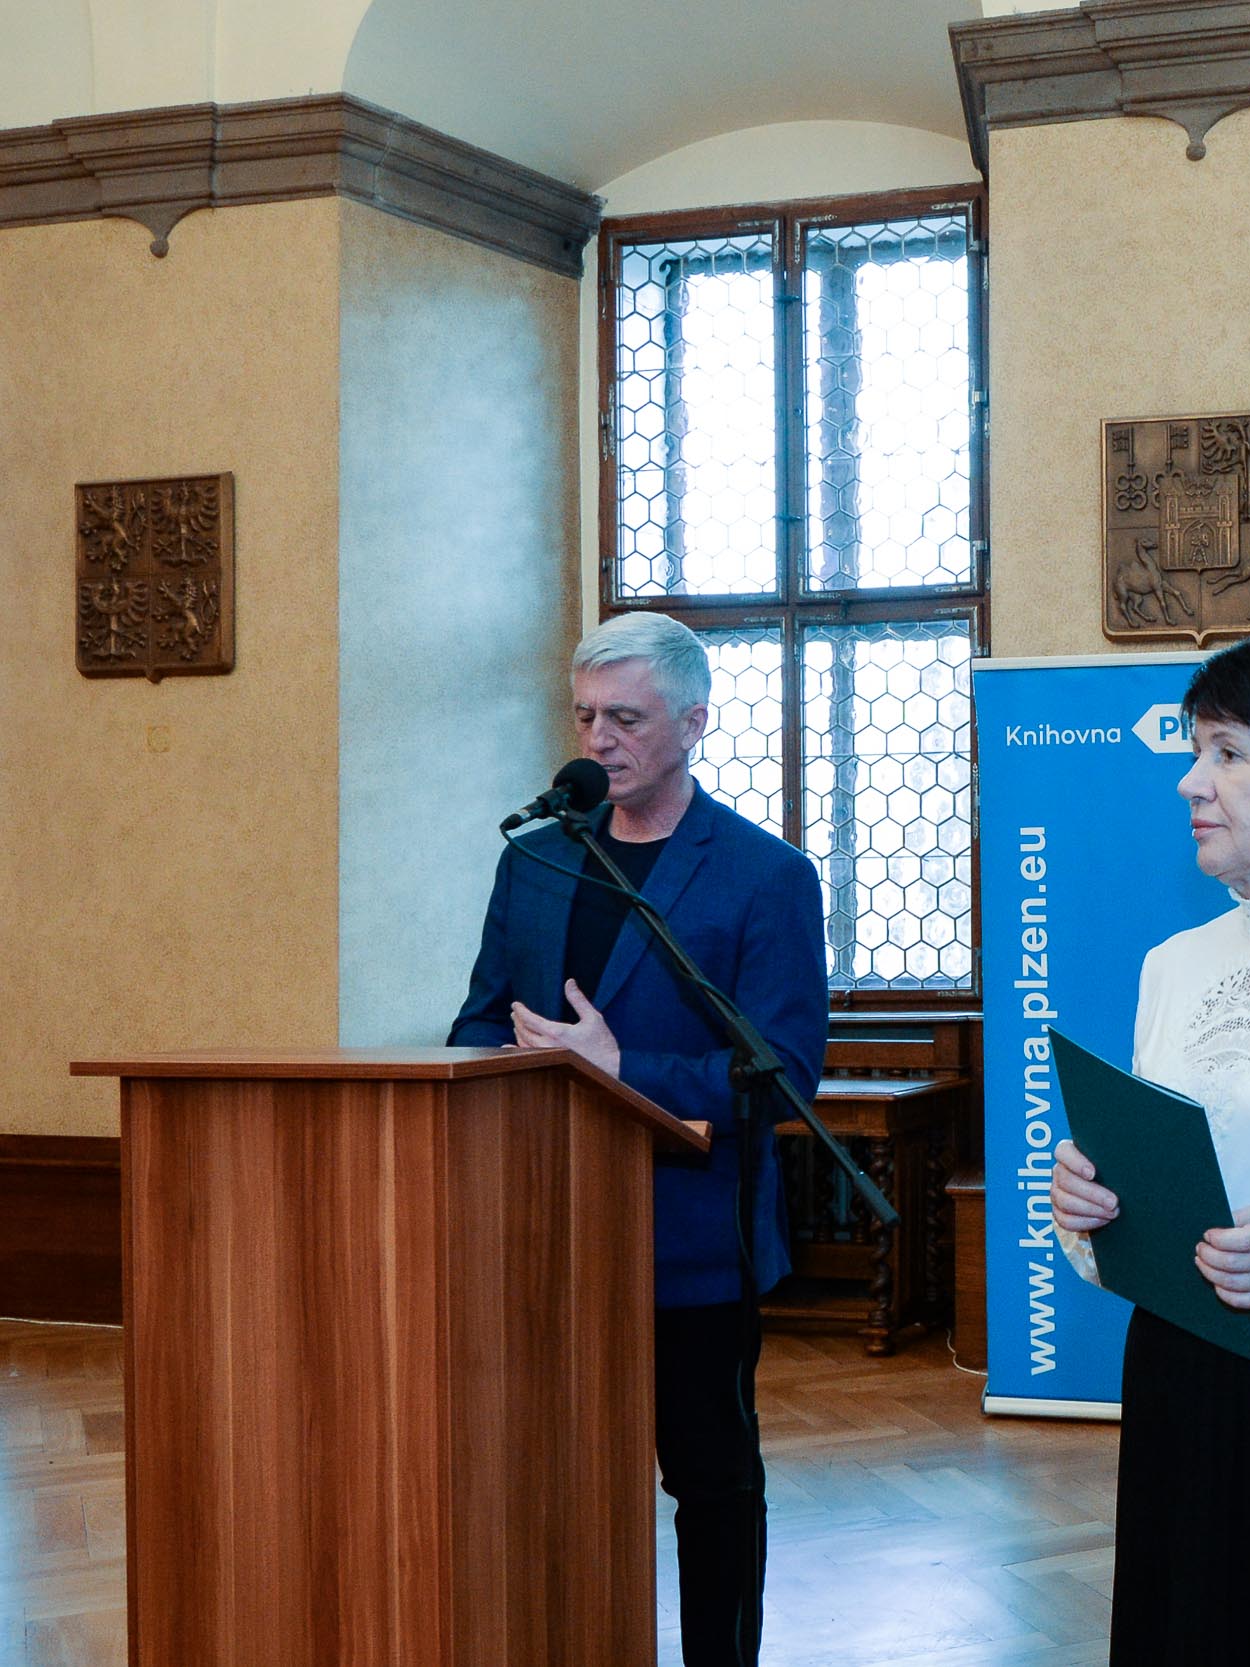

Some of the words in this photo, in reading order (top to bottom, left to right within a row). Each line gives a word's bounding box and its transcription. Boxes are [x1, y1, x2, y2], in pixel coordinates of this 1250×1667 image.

[1006, 724, 1121, 747] Knihovna
[1159, 715, 1189, 741] Pl
[1013, 826, 1058, 1377] www.knihovna.plzen.eu
